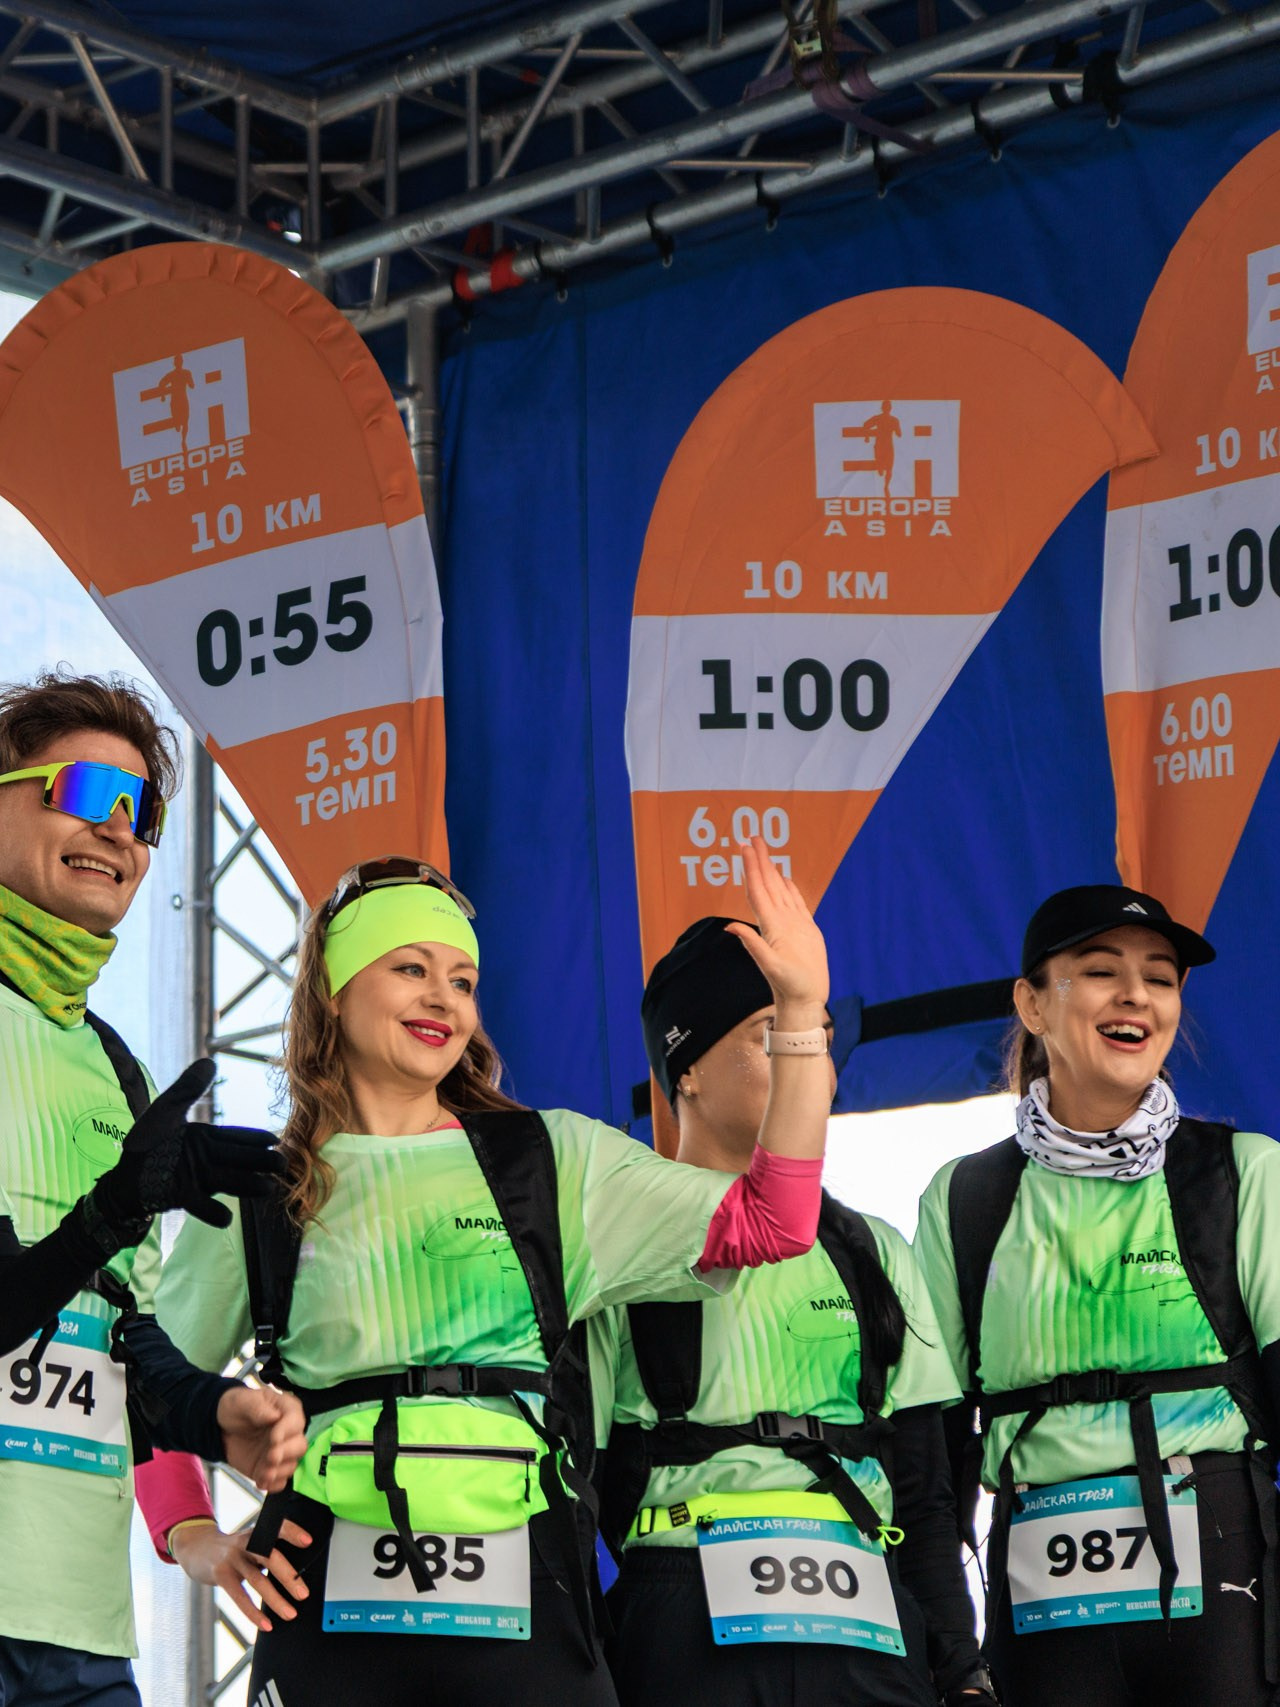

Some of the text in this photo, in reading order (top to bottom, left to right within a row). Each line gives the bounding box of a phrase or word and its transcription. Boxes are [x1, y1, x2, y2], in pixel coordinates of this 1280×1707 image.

[128, 438, 245, 486] EUROPE
[1195, 427, 1241, 476] 10
[131, 459, 247, 507] ASIA
[191, 503, 243, 554] 10
[824, 499, 952, 517] EUROPE
[824, 519, 953, 537] ASIA
[743, 560, 803, 600] 10
[196, 574, 374, 688] 0:55
[699, 658, 891, 732] 1:00
[1160, 693, 1234, 746] 6.00
[305, 721, 398, 784] 5.30
[1152, 743, 1236, 787] темп
[295, 770, 397, 826] темп
[688, 806, 790, 849] 6.00
[1120, 1249, 1183, 1267] МАЙСК
[9, 1358, 96, 1416] 974
[1078, 1488, 1114, 1502] ГРОЗА
[709, 1519, 784, 1536] МАЙСКАЯ
[1046, 1526, 1150, 1577] 987
[373, 1534, 486, 1583] 985
[750, 1555, 859, 1599] 980
